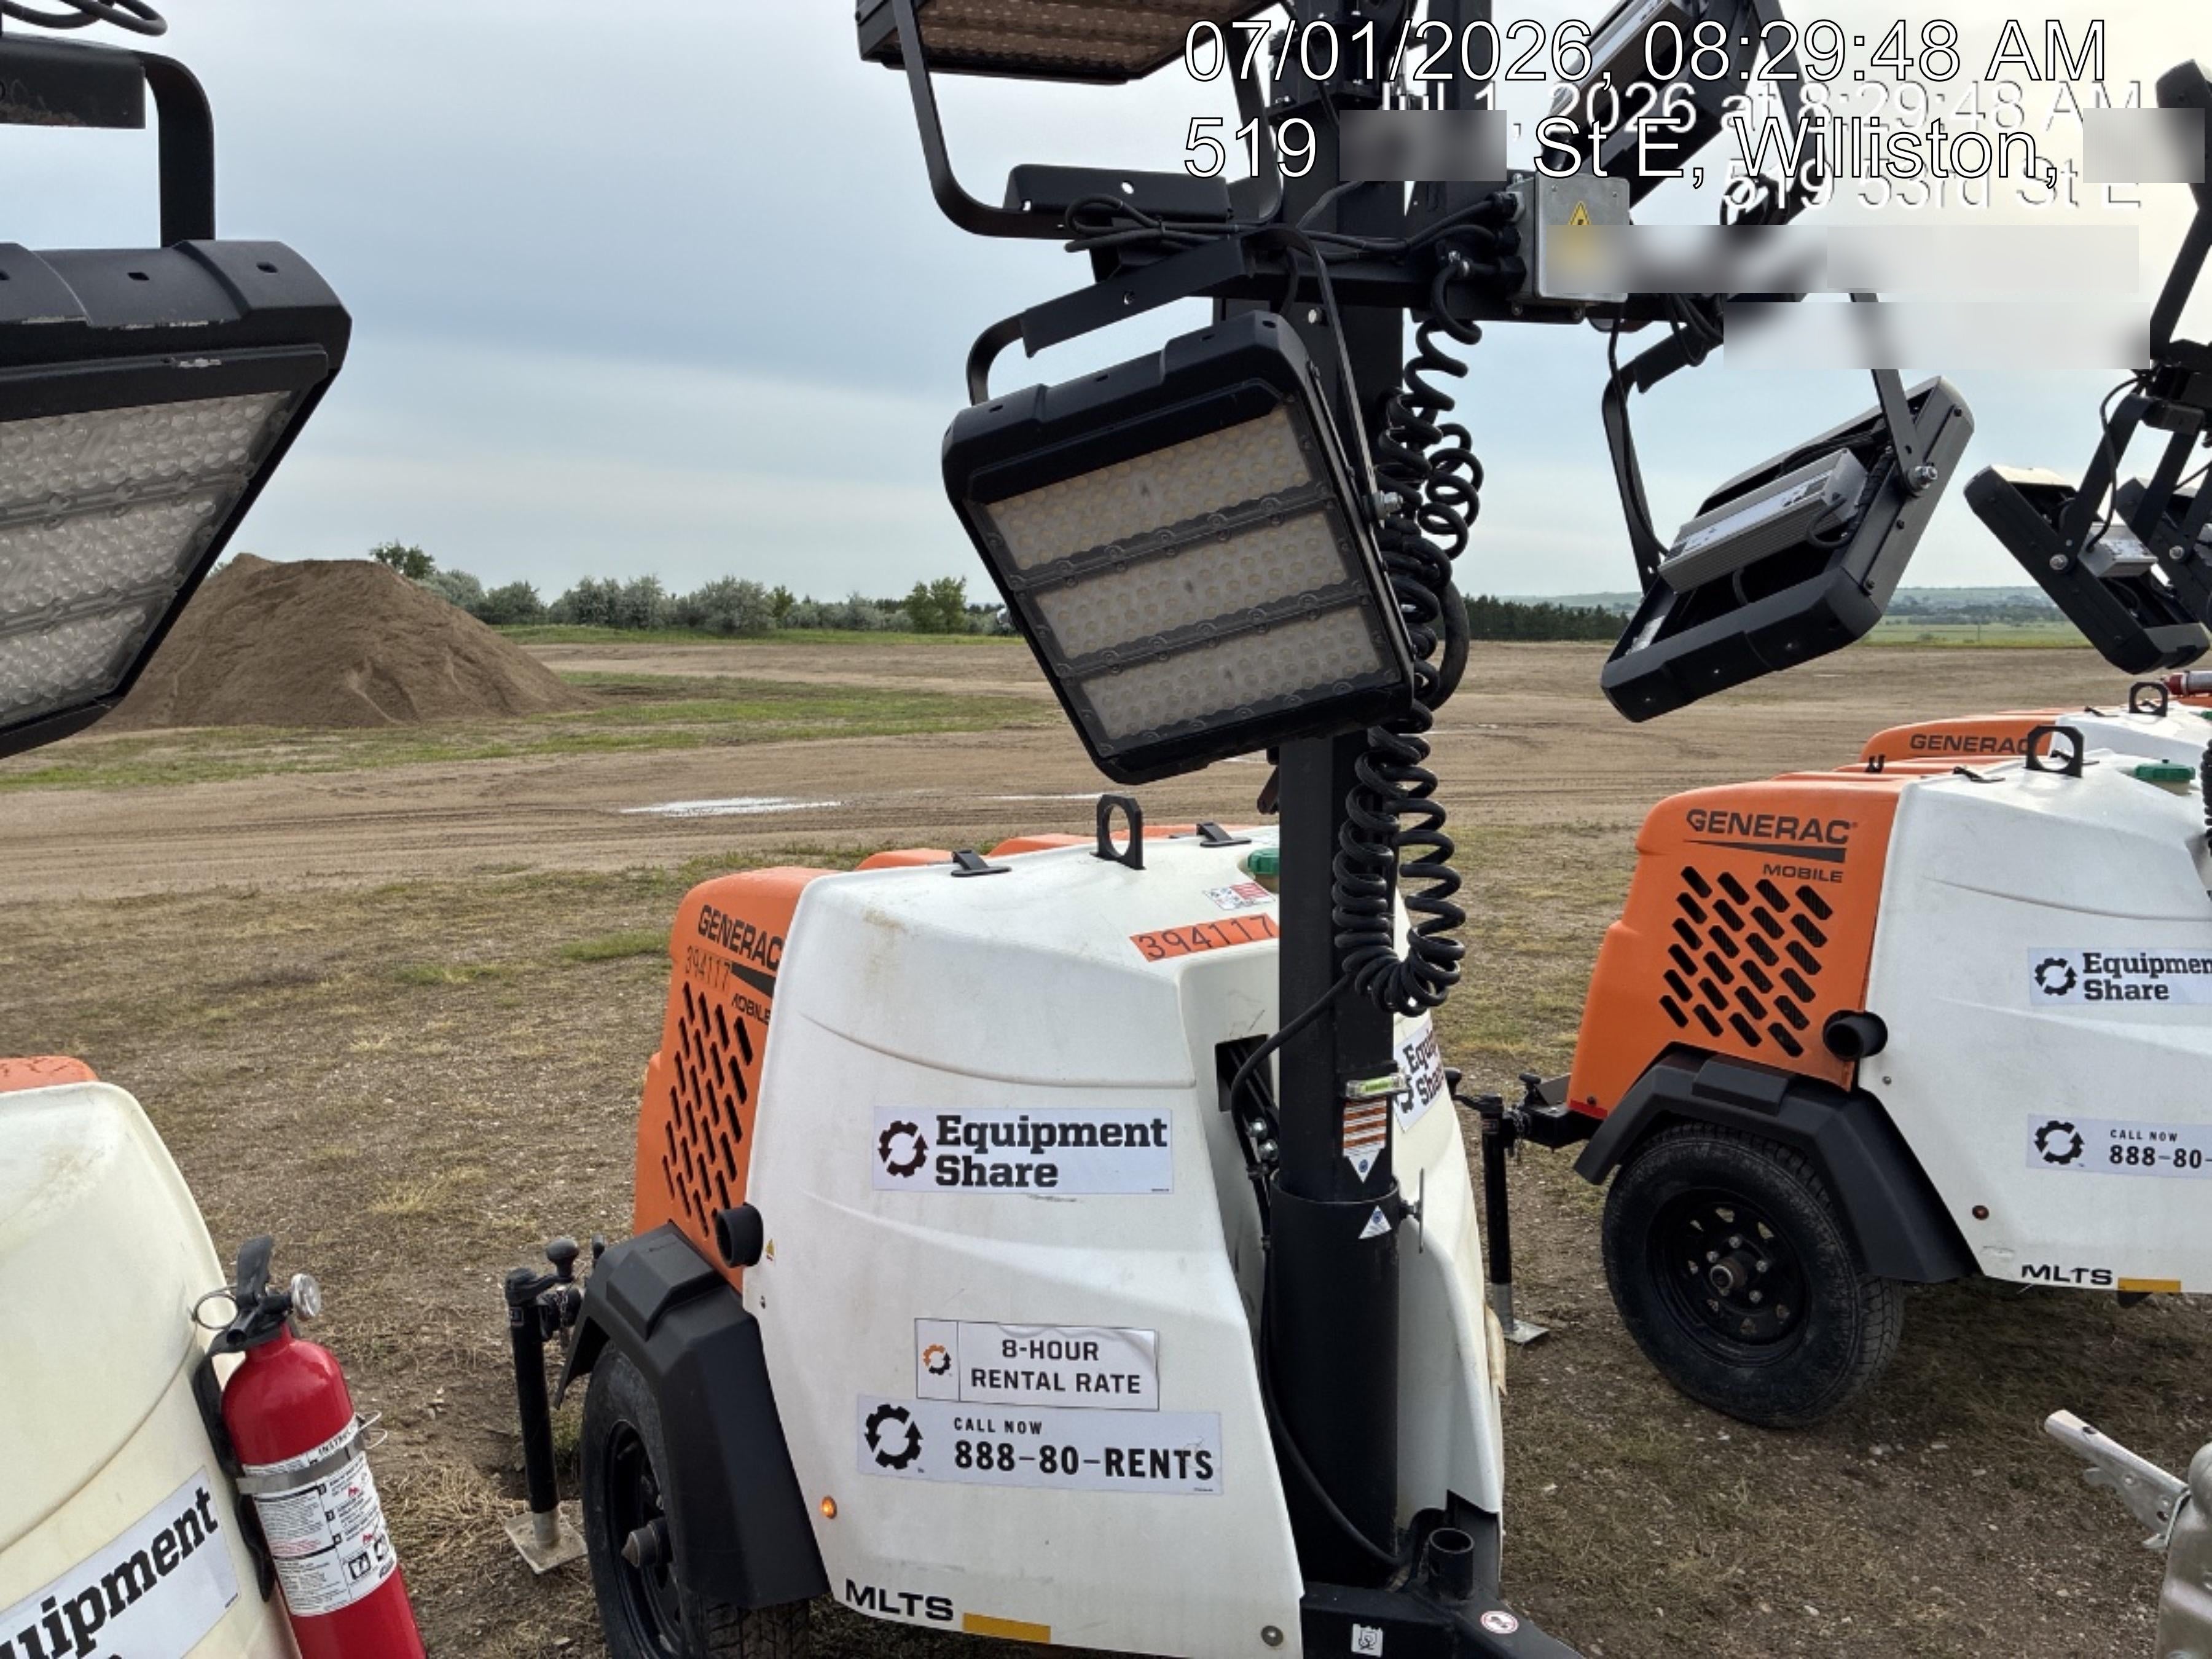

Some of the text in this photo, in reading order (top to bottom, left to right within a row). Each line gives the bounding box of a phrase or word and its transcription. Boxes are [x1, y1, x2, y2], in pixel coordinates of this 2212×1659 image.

[1910, 734, 2028, 755] GENERAC
[1686, 808, 1852, 845] GENERAC
[1763, 863, 1844, 884] MOBILE
[698, 904, 783, 972] GENERAC
[1139, 916, 1274, 959] 394117
[2082, 952, 2212, 979] Equipmen
[2084, 979, 2170, 1001] Share
[935, 1115, 1167, 1155] Equipment
[2110, 1129, 2178, 1143] CALL NOW
[935, 1155, 1059, 1188] Share
[2022, 1264, 2113, 1285] MLTS
[1002, 1339, 1099, 1362] 8-HOUR
[971, 1368, 1141, 1394] RENTAL RATE
[954, 1417, 1043, 1435] CALL NOW
[954, 1440, 1214, 1480] 888-80-RENTS
[845, 1578, 954, 1622] MLTS
